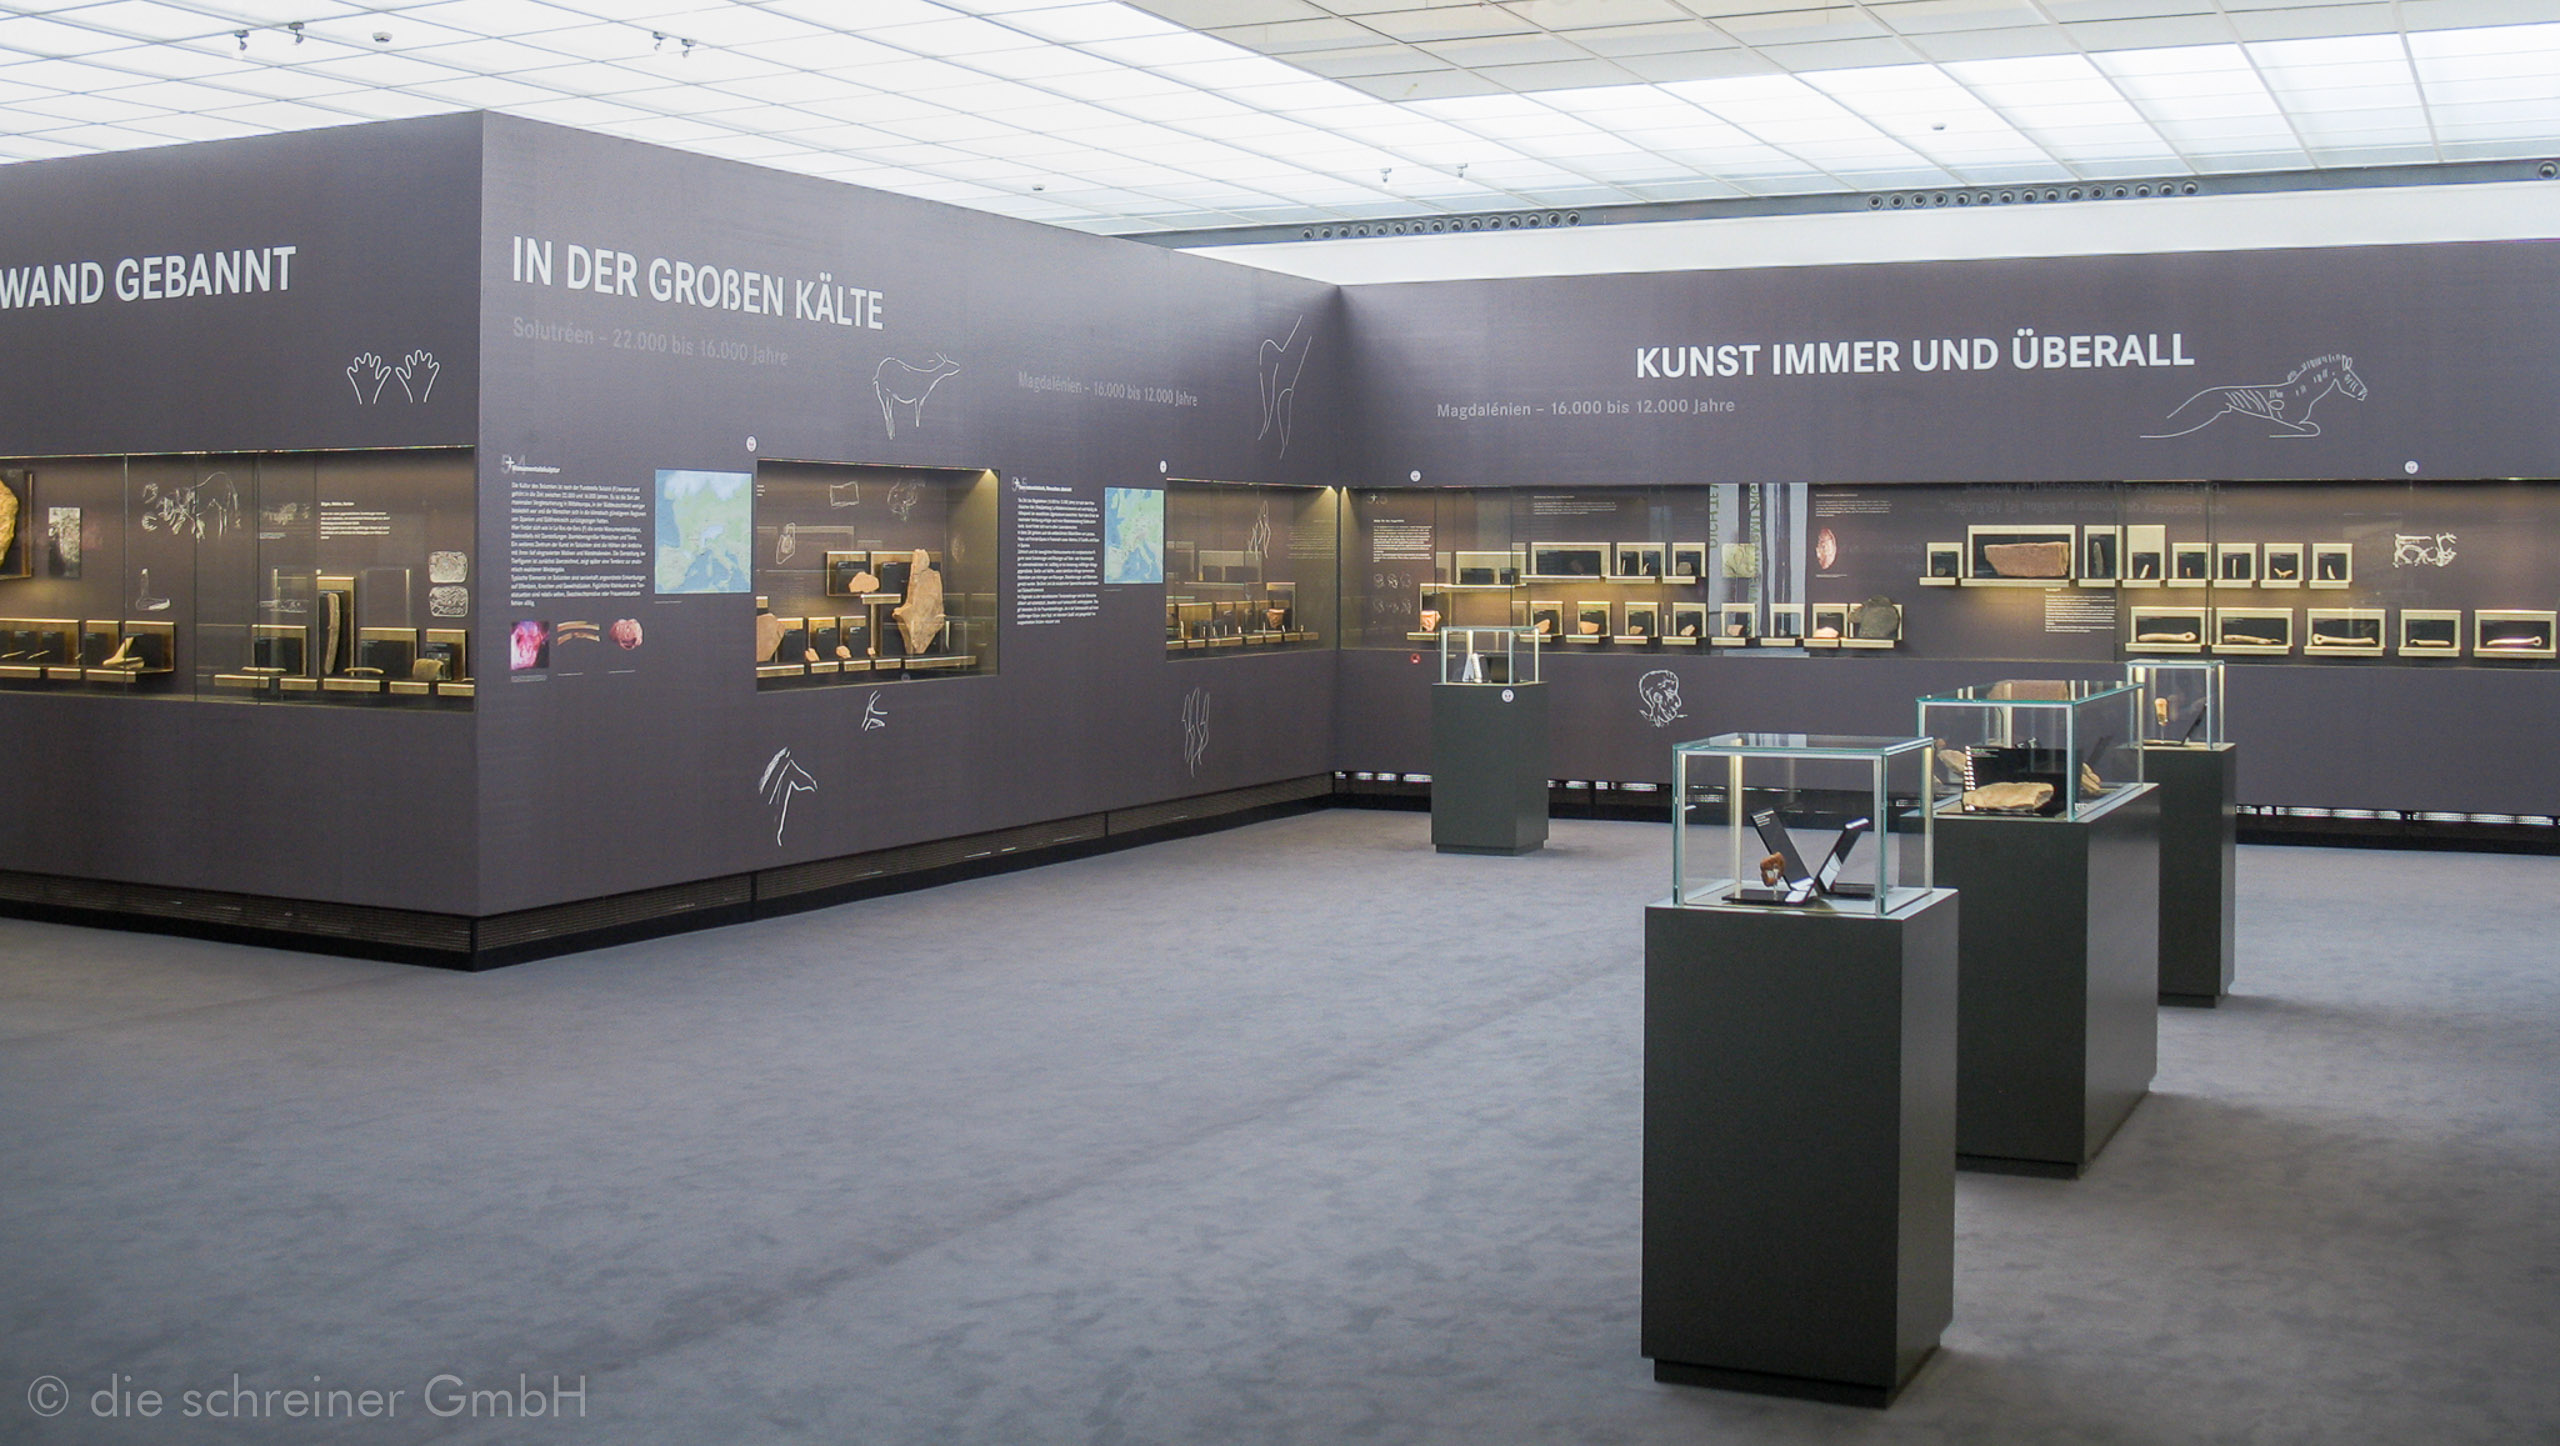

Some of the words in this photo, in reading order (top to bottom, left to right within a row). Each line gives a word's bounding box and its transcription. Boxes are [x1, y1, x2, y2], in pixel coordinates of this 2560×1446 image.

[0, 262, 104, 310] WAND
[115, 246, 297, 302] GEBANNT
[513, 236, 552, 285] IN
[567, 245, 638, 297] DER
[796, 272, 883, 330] KÄLTE
[512, 316, 594, 345] Solutréen
[613, 328, 667, 352] 22.000
[672, 336, 694, 356] bis
[701, 340, 749, 362] 16.000
[753, 346, 789, 366] Jahre
[1637, 344, 1761, 379] KUNST
[1772, 341, 1901, 375] IMMER
[1912, 338, 1999, 372] UND
[2012, 327, 2196, 370] ÜBERALL
[1018, 371, 1083, 395] Magdalénien
[1093, 381, 1126, 399] 16.000
[1126, 384, 1141, 400] bis
[1143, 387, 1174, 405] 12.000
[1175, 390, 1199, 408] Jahre
[1436, 401, 1531, 421] Magdalénien
[1551, 400, 1602, 416] 16.000
[1606, 399, 1630, 415] bis
[1636, 399, 1689, 415] 12.000
[1691, 397, 1736, 415] Jahre
